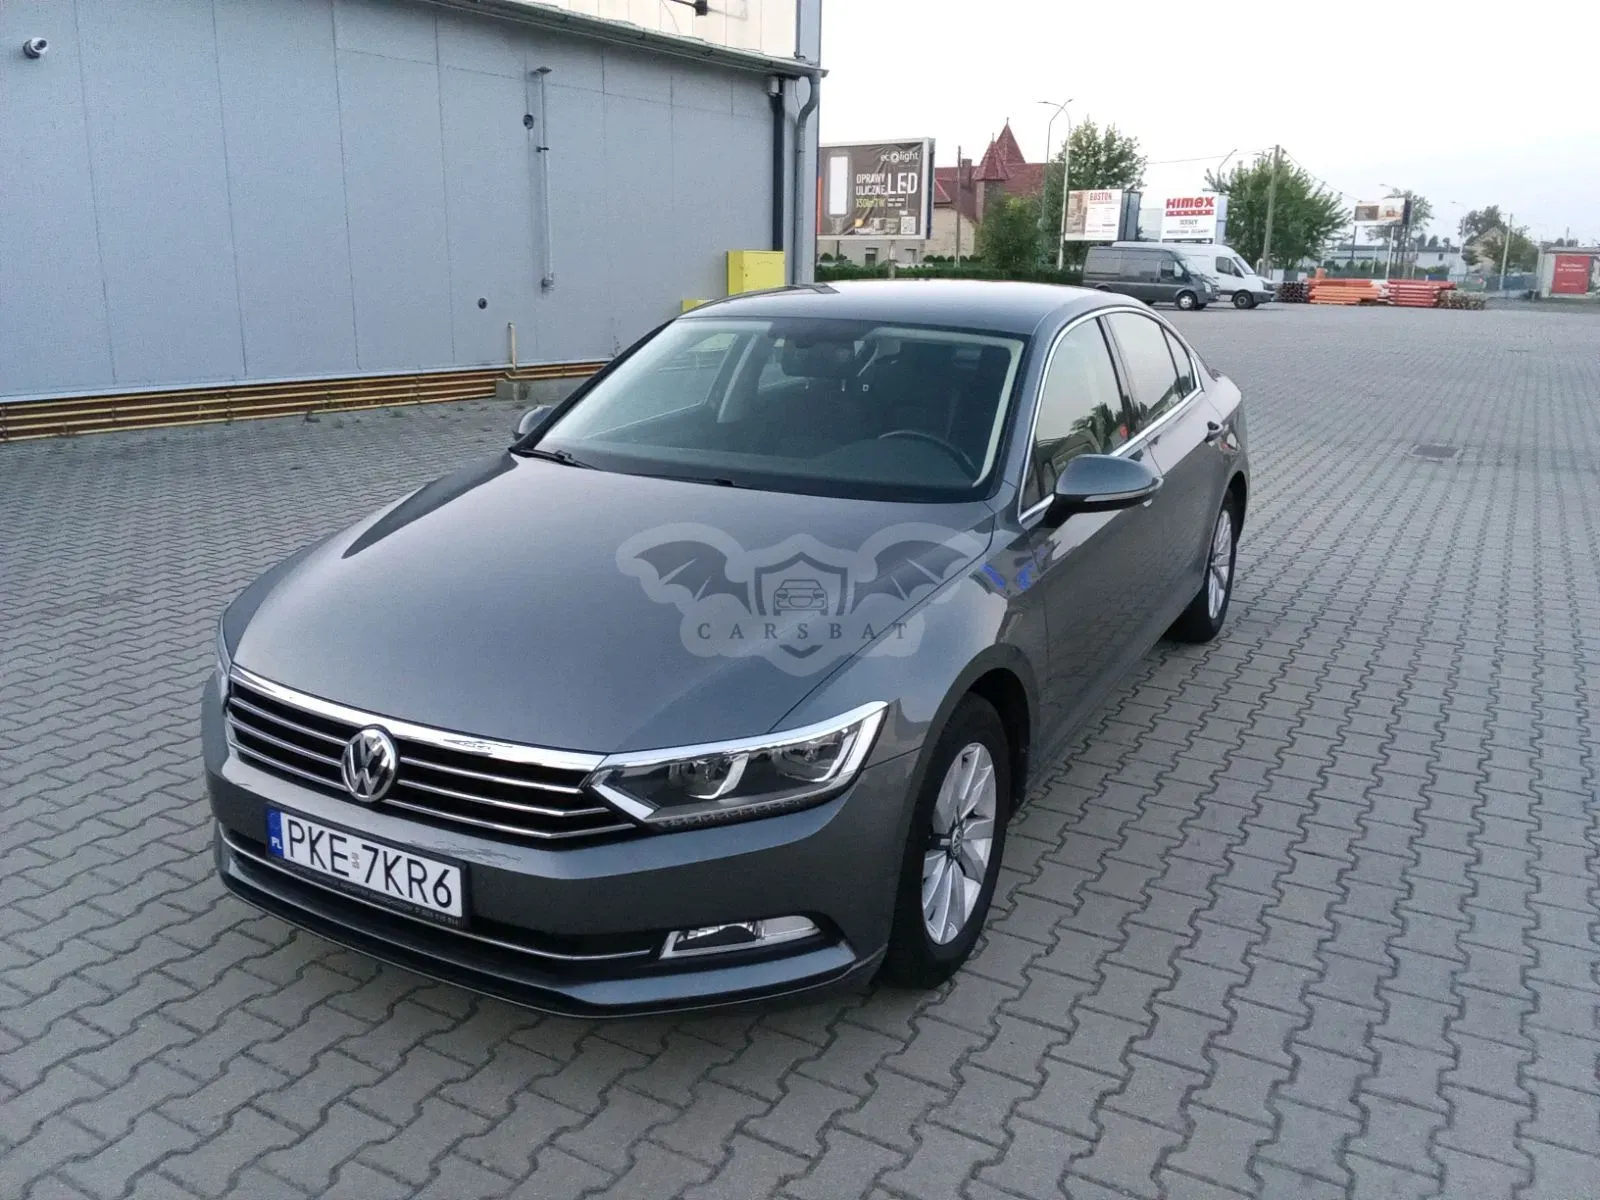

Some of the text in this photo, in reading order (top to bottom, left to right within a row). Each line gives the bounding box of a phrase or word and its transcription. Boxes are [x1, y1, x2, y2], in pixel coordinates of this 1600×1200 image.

[856, 173, 886, 184] OPRAWY
[887, 172, 918, 194] LED
[271, 836, 283, 850] PL
[287, 819, 350, 878] PKE
[361, 843, 453, 909] 7KR6
